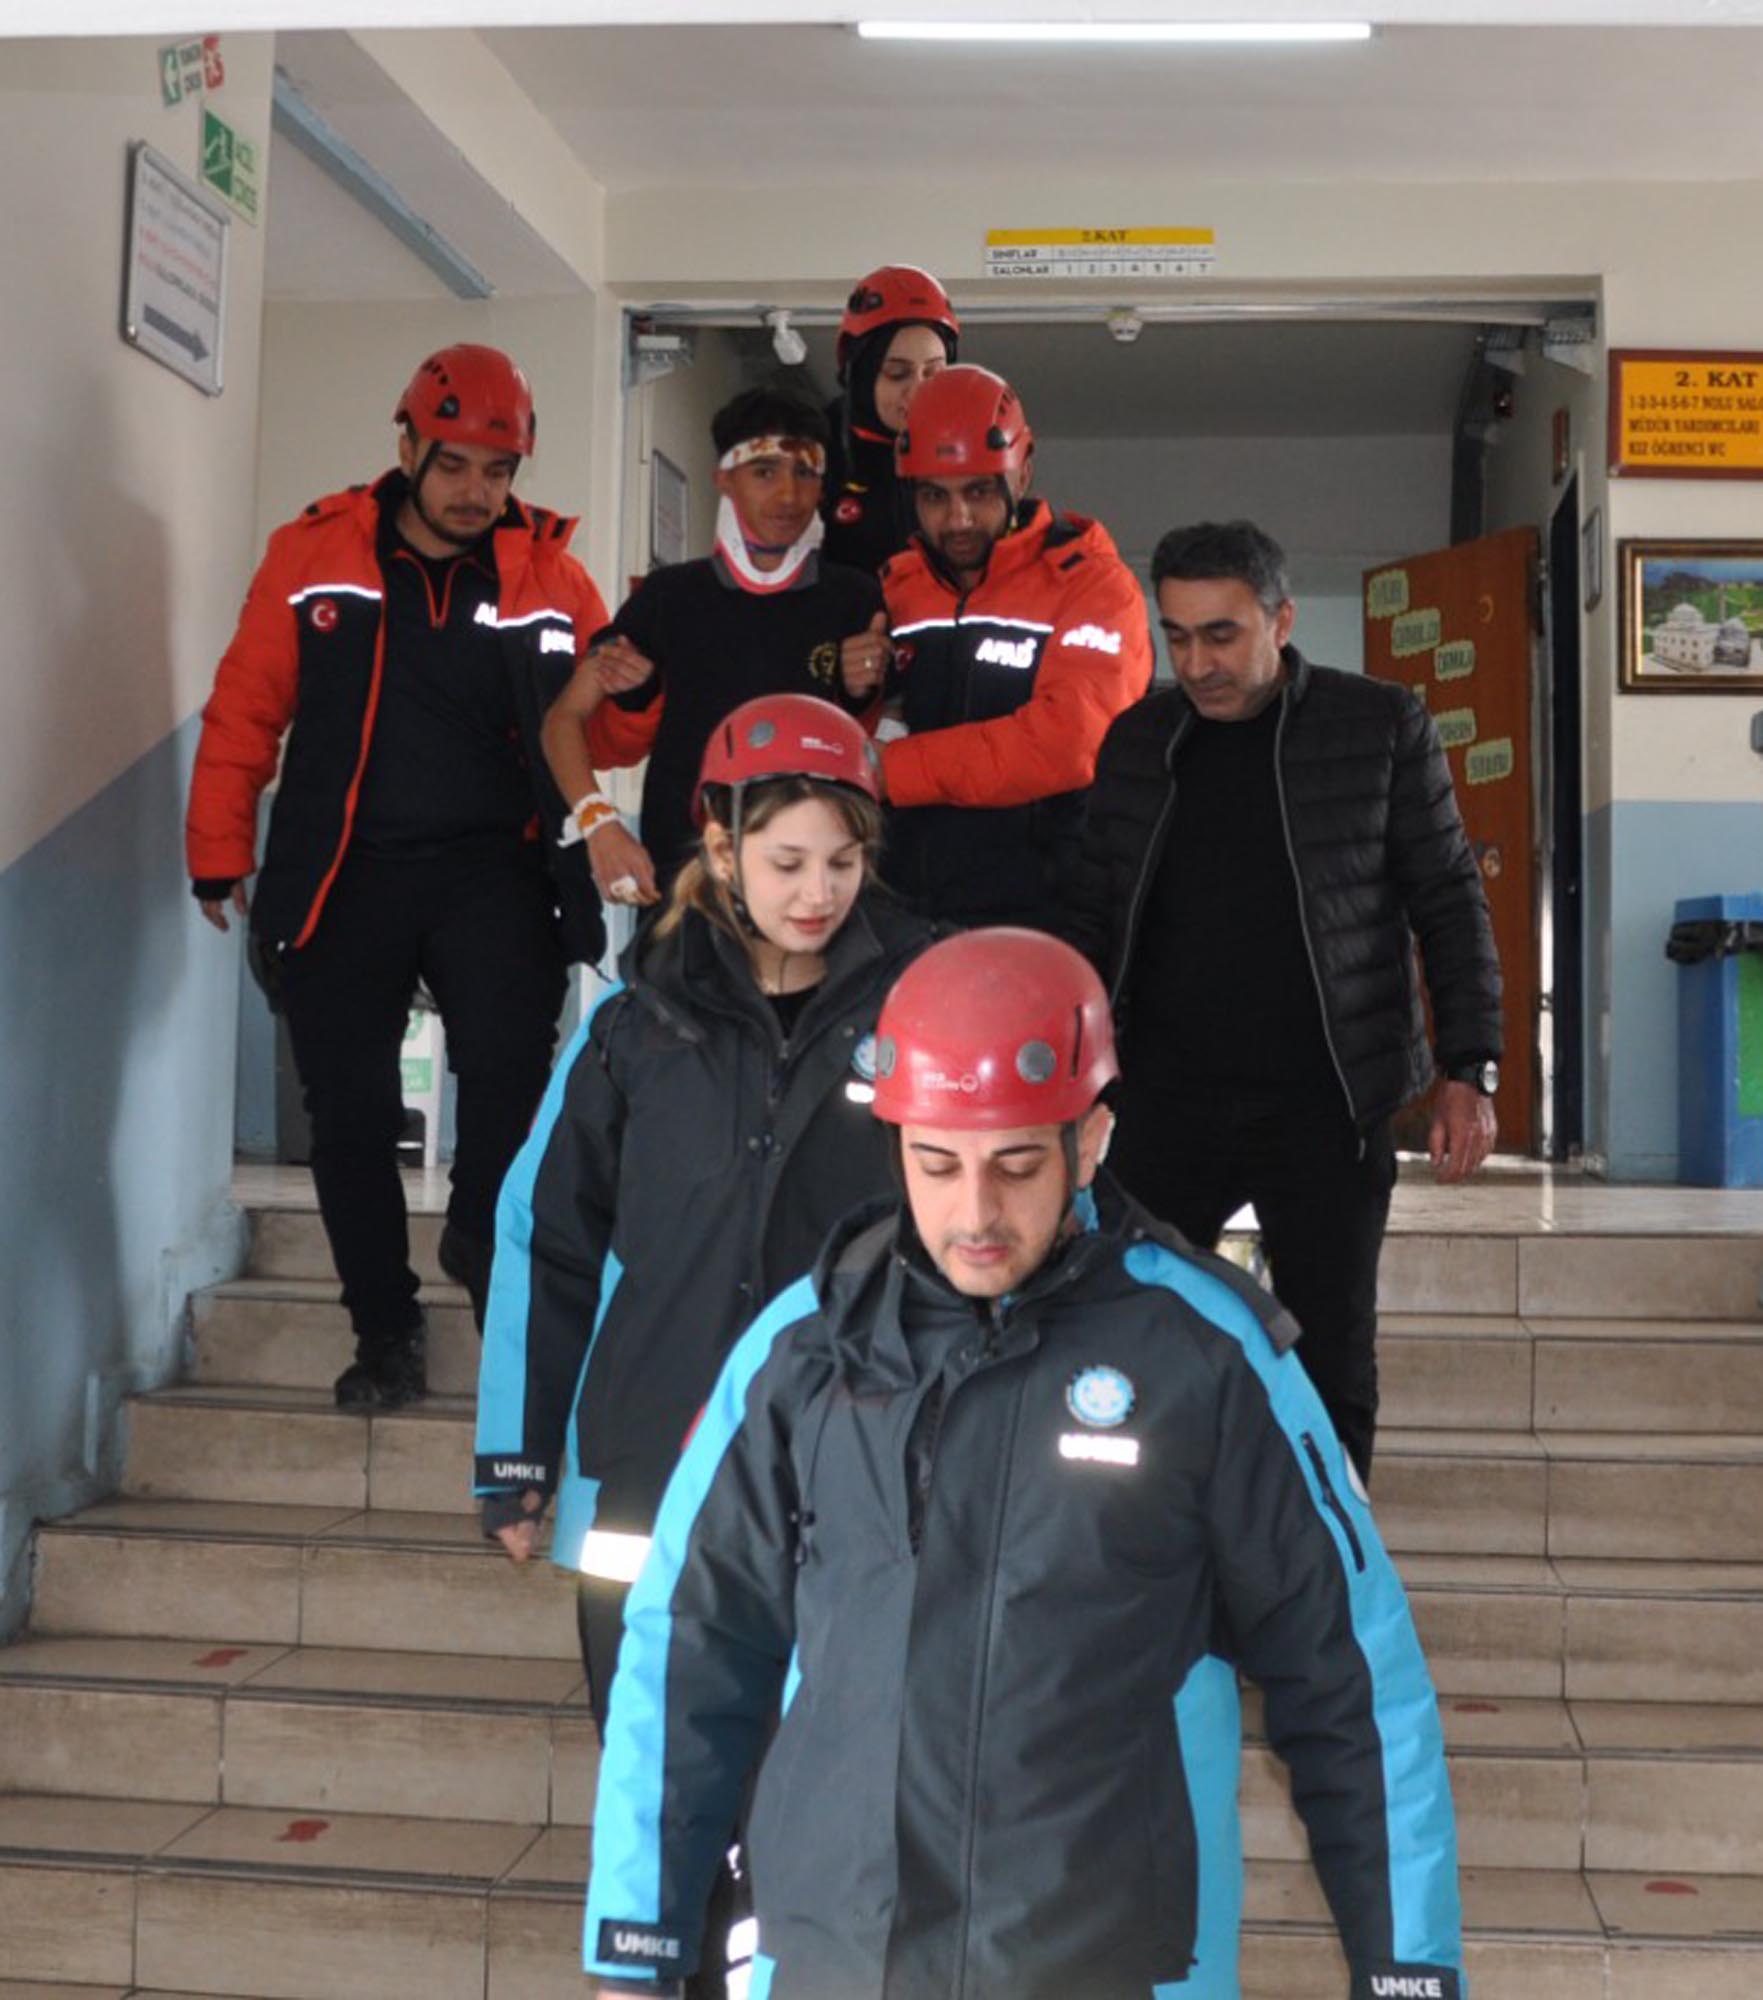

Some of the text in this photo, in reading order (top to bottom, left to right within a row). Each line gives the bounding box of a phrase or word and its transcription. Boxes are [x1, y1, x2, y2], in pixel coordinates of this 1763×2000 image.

[1675, 371, 1760, 388] 2. KAT
[493, 1462, 547, 1481] UMKE
[613, 1930, 680, 1959] UMKE
[1370, 1975, 1443, 1998] UMKE
